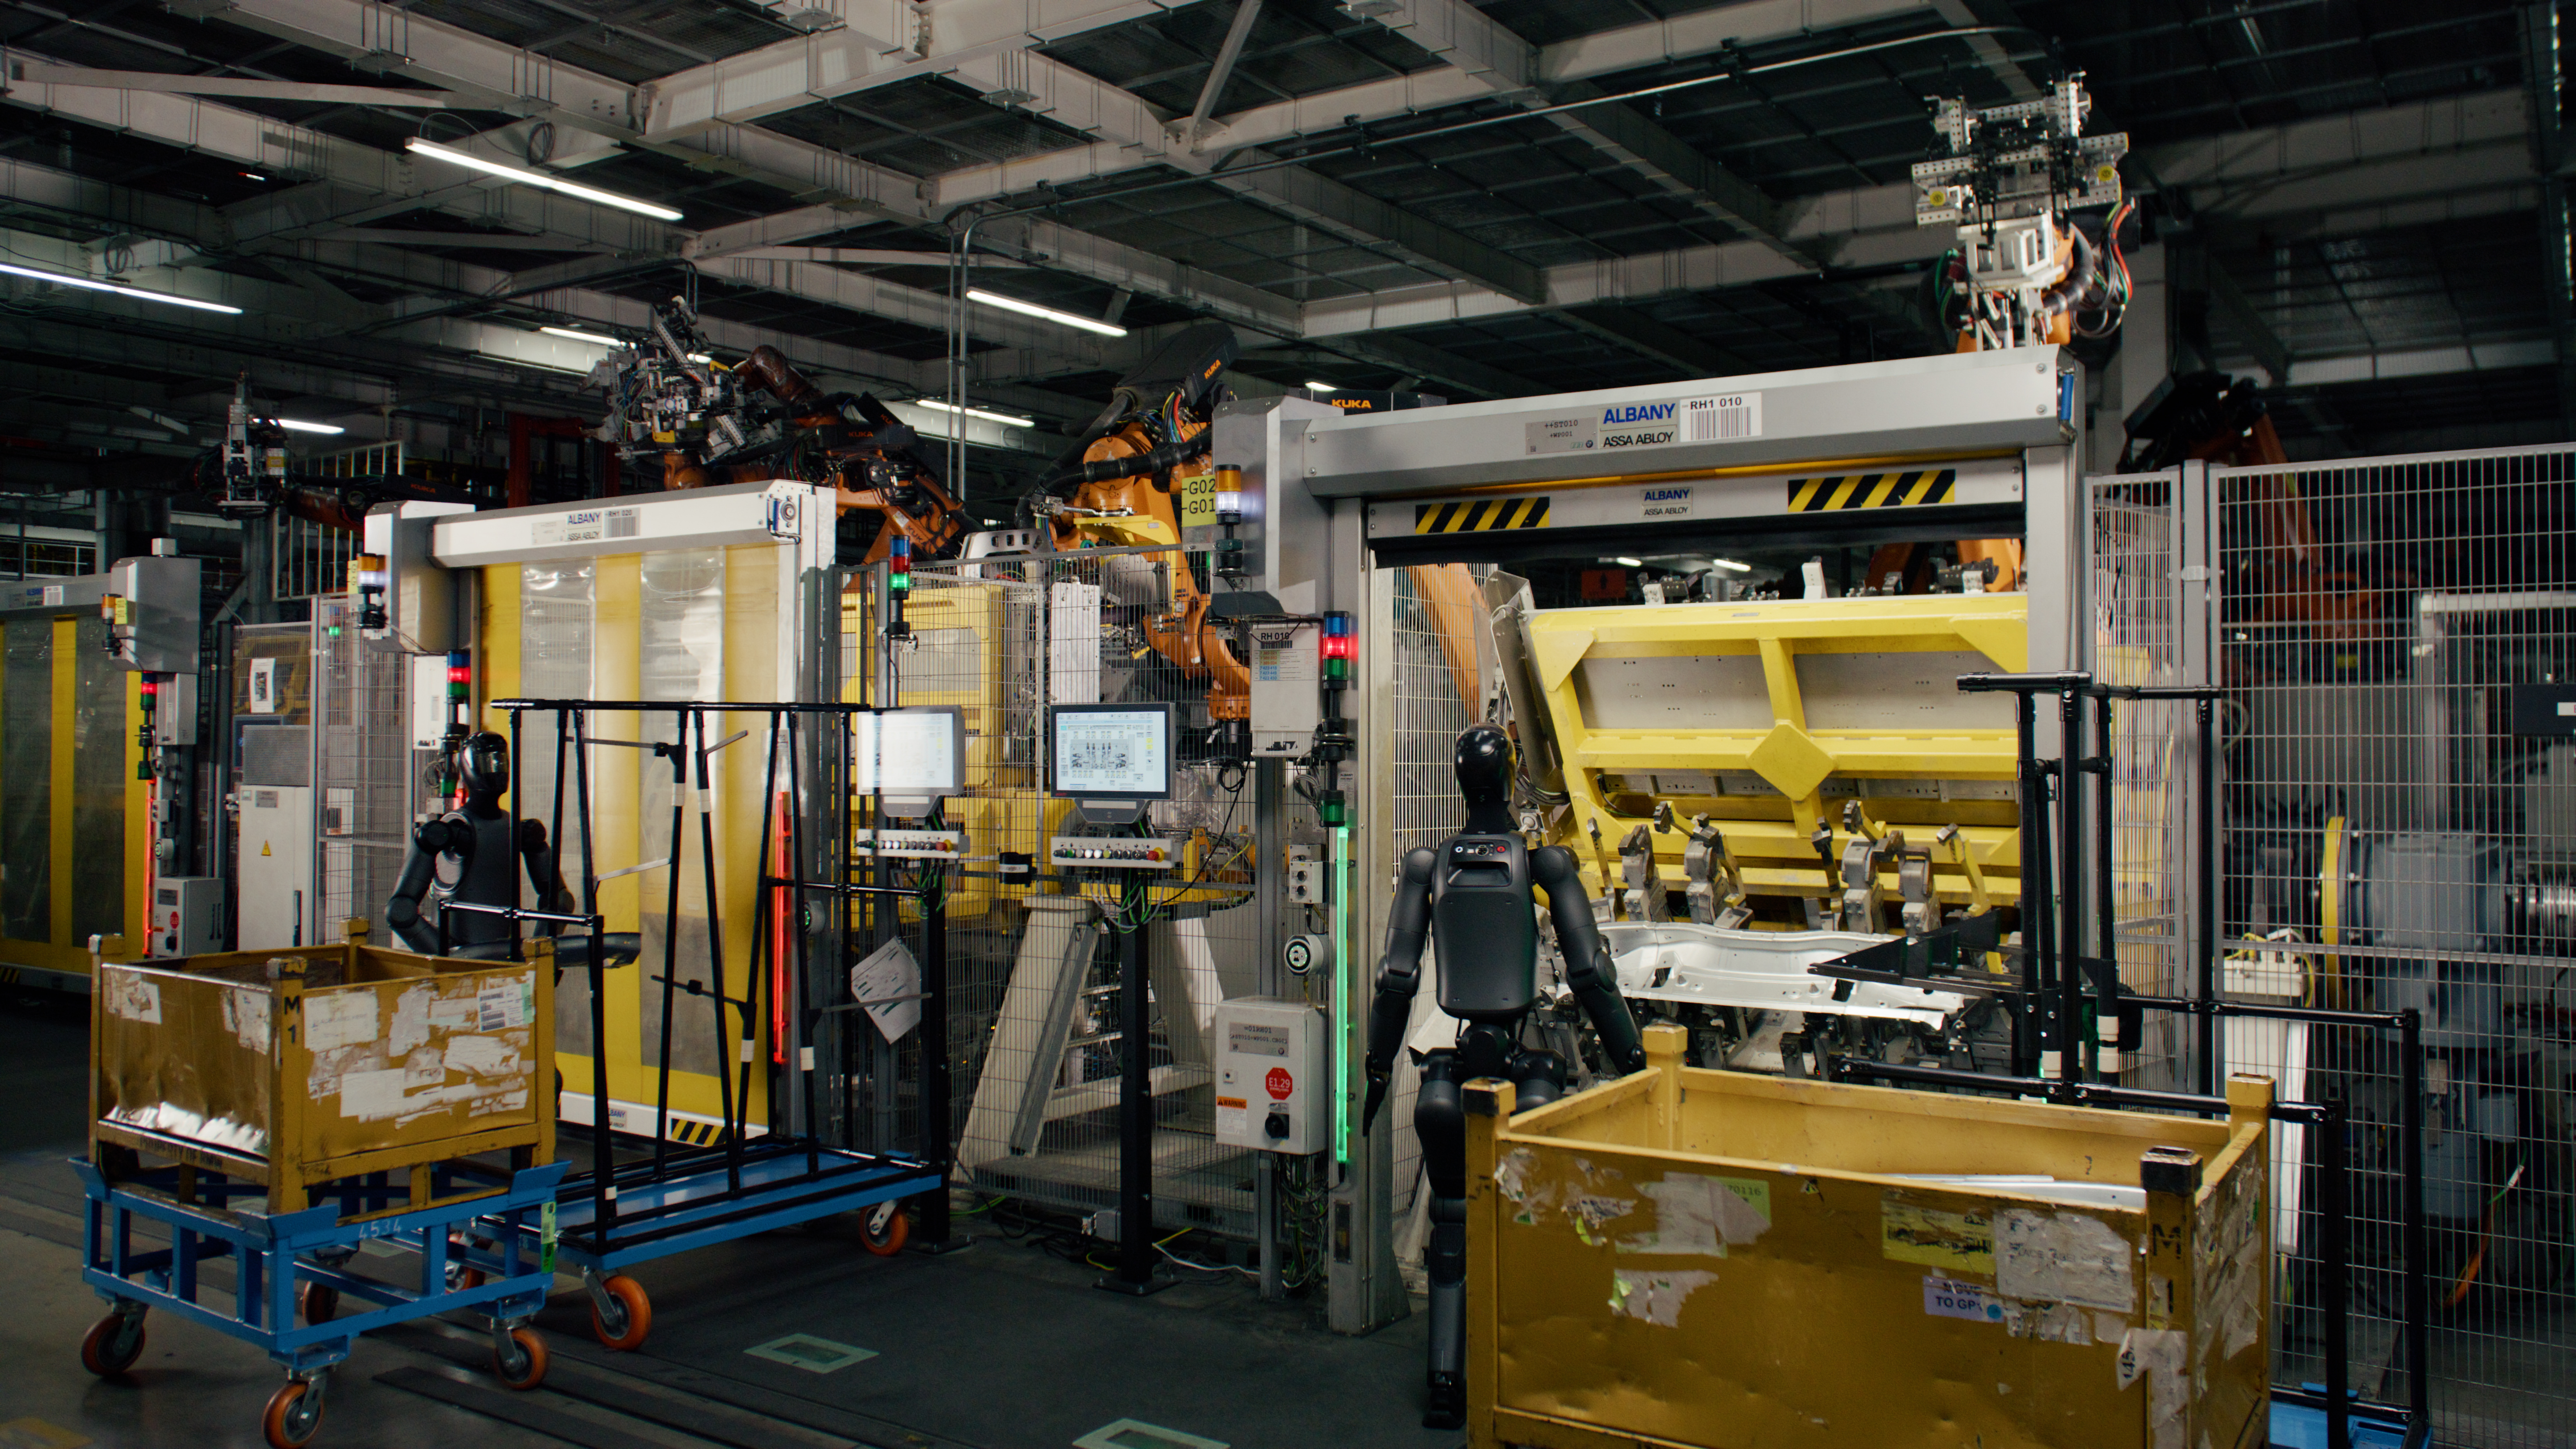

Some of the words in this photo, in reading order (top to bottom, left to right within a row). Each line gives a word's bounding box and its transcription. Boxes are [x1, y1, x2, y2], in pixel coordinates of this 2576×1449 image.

[1204, 359, 1221, 379] KUKA
[1332, 399, 1372, 409] KUKA
[1690, 399, 1714, 410] RH1
[1720, 397, 1742, 407] 010
[1603, 403, 1676, 424] ALBANY
[1603, 435, 1633, 447] ASSA
[1635, 432, 1674, 445] ABLOY
[1182, 478, 1216, 495] -G02
[1644, 489, 1690, 501] ALBANY
[1182, 498, 1216, 514] -G01
[1665, 507, 1688, 515] ABLOY
[567, 512, 601, 525] ALBANY
[582, 531, 600, 539] ABLOY
[1275, 632, 1289, 640] 010
[284, 996, 300, 1015] M
[288, 1024, 296, 1044] 1
[1269, 1077, 1291, 1089] E1.29
[1223, 1100, 1246, 1109] WARNING
[2152, 1224, 2182, 1259] M
[1936, 1295, 1954, 1308] TO
